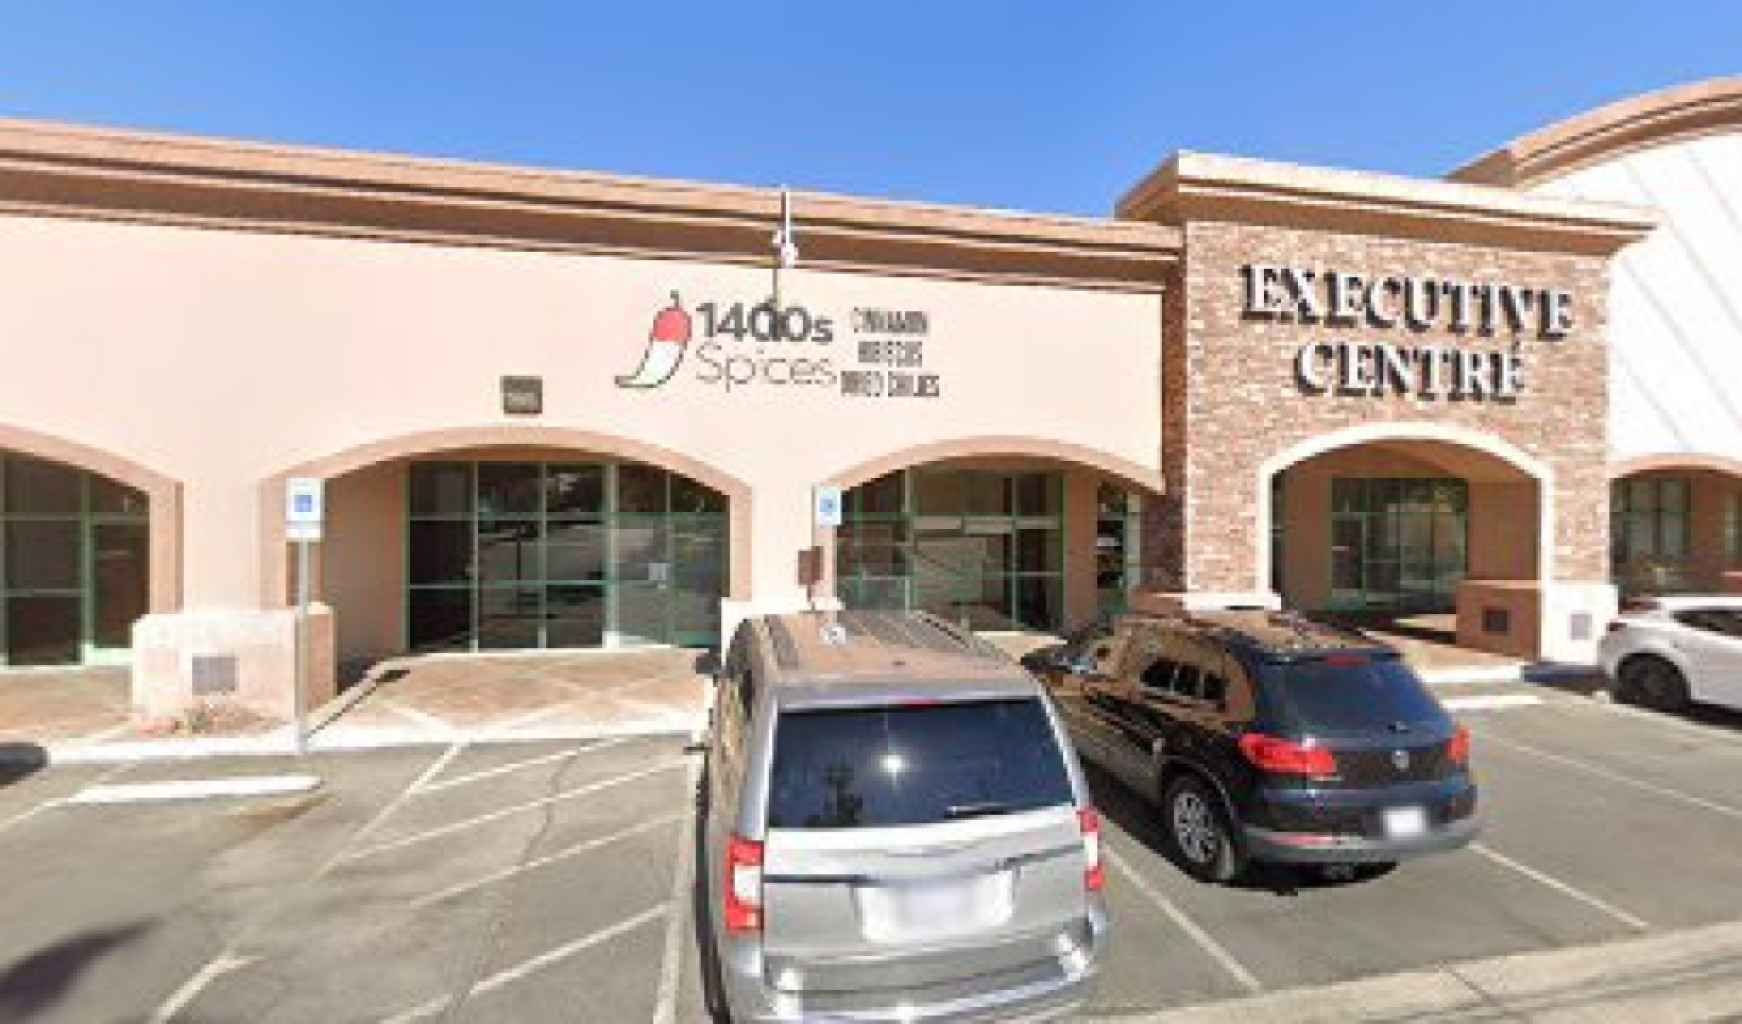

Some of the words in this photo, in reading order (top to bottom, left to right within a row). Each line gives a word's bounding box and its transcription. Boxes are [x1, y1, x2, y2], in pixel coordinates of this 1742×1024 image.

[696, 302, 834, 343] 1400s
[1239, 264, 1573, 341] EXECUTIVE
[694, 342, 836, 392] Spices
[1295, 342, 1525, 405] CENTRE
